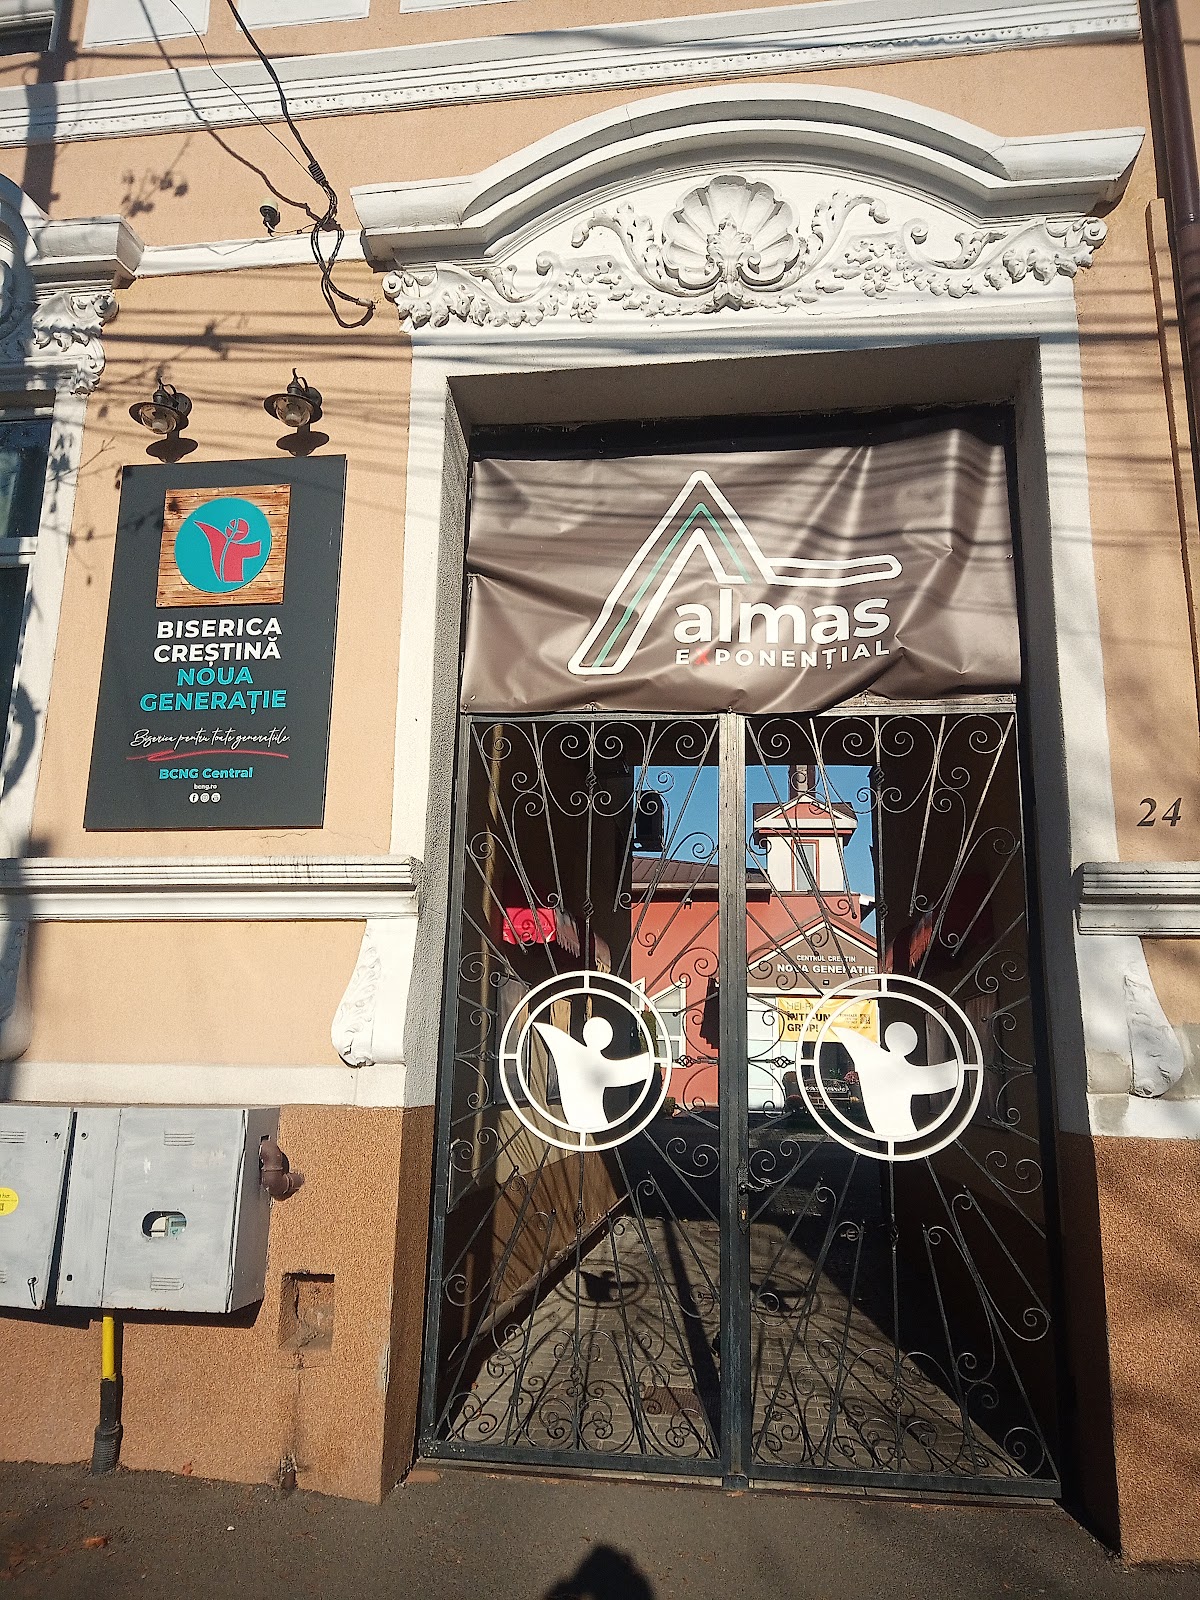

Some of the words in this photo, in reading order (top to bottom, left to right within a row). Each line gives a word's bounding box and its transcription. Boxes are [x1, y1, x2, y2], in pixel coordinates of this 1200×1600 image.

[673, 588, 891, 645] almas
[156, 617, 282, 639] BISERICA
[153, 637, 281, 667] CREȘTINĂ
[675, 639, 891, 670] EXPONENȚIAL
[176, 666, 254, 686] NOUA
[139, 689, 287, 715] GENERAȚIE
[173, 727, 210, 750] pentru
[210, 727, 236, 746] toate
[159, 768, 199, 780] BCNG
[202, 767, 254, 779] Central
[193, 783, 218, 791] bcng.ro
[1136, 797, 1182, 827] 24
[796, 954, 826, 962] CENTRUL
[827, 955, 856, 963] CRETIN
[787, 1023, 819, 1033] GRP!
